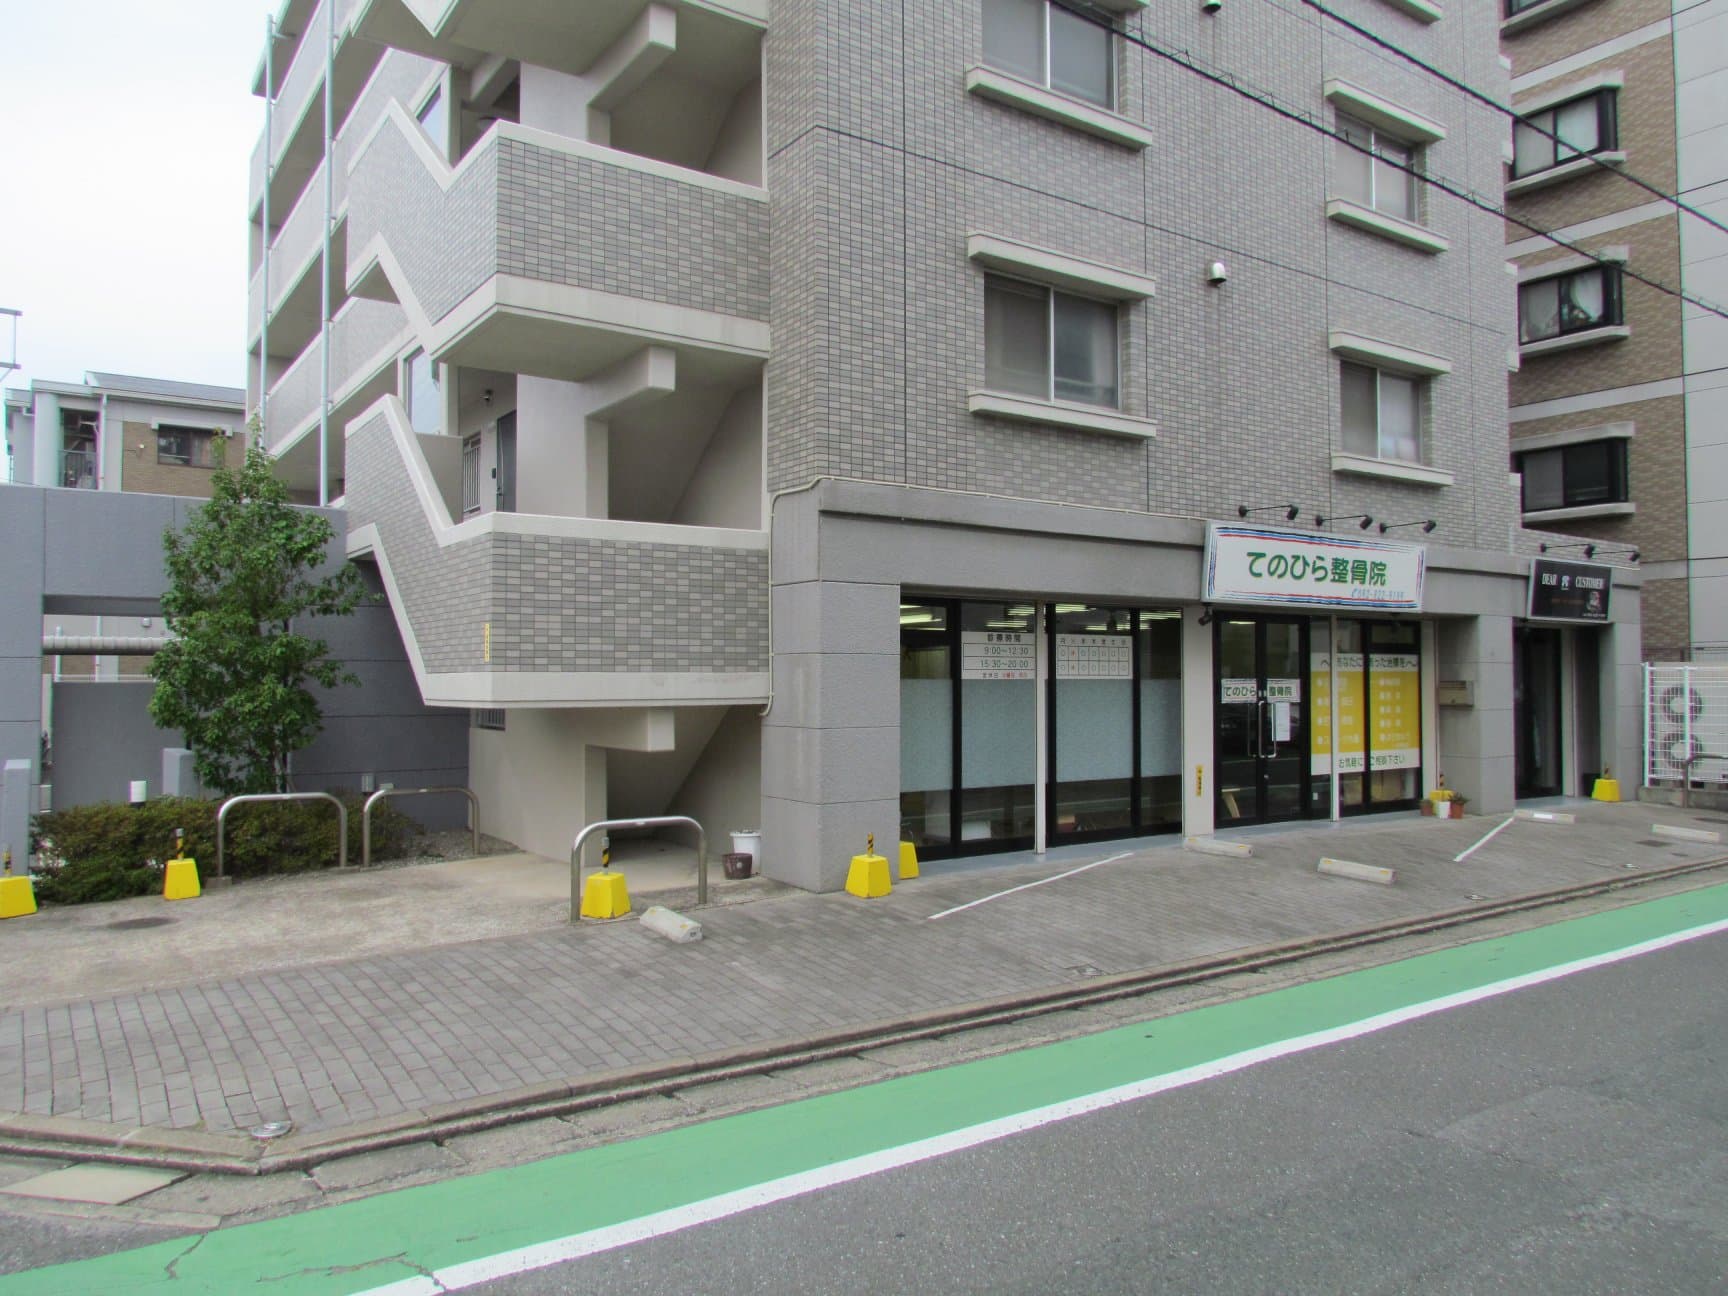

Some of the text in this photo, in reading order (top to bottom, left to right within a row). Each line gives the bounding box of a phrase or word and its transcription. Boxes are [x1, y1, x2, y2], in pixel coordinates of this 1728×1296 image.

[1247, 551, 1387, 586] てのひら整骨院
[1224, 686, 1257, 697] てのひら
